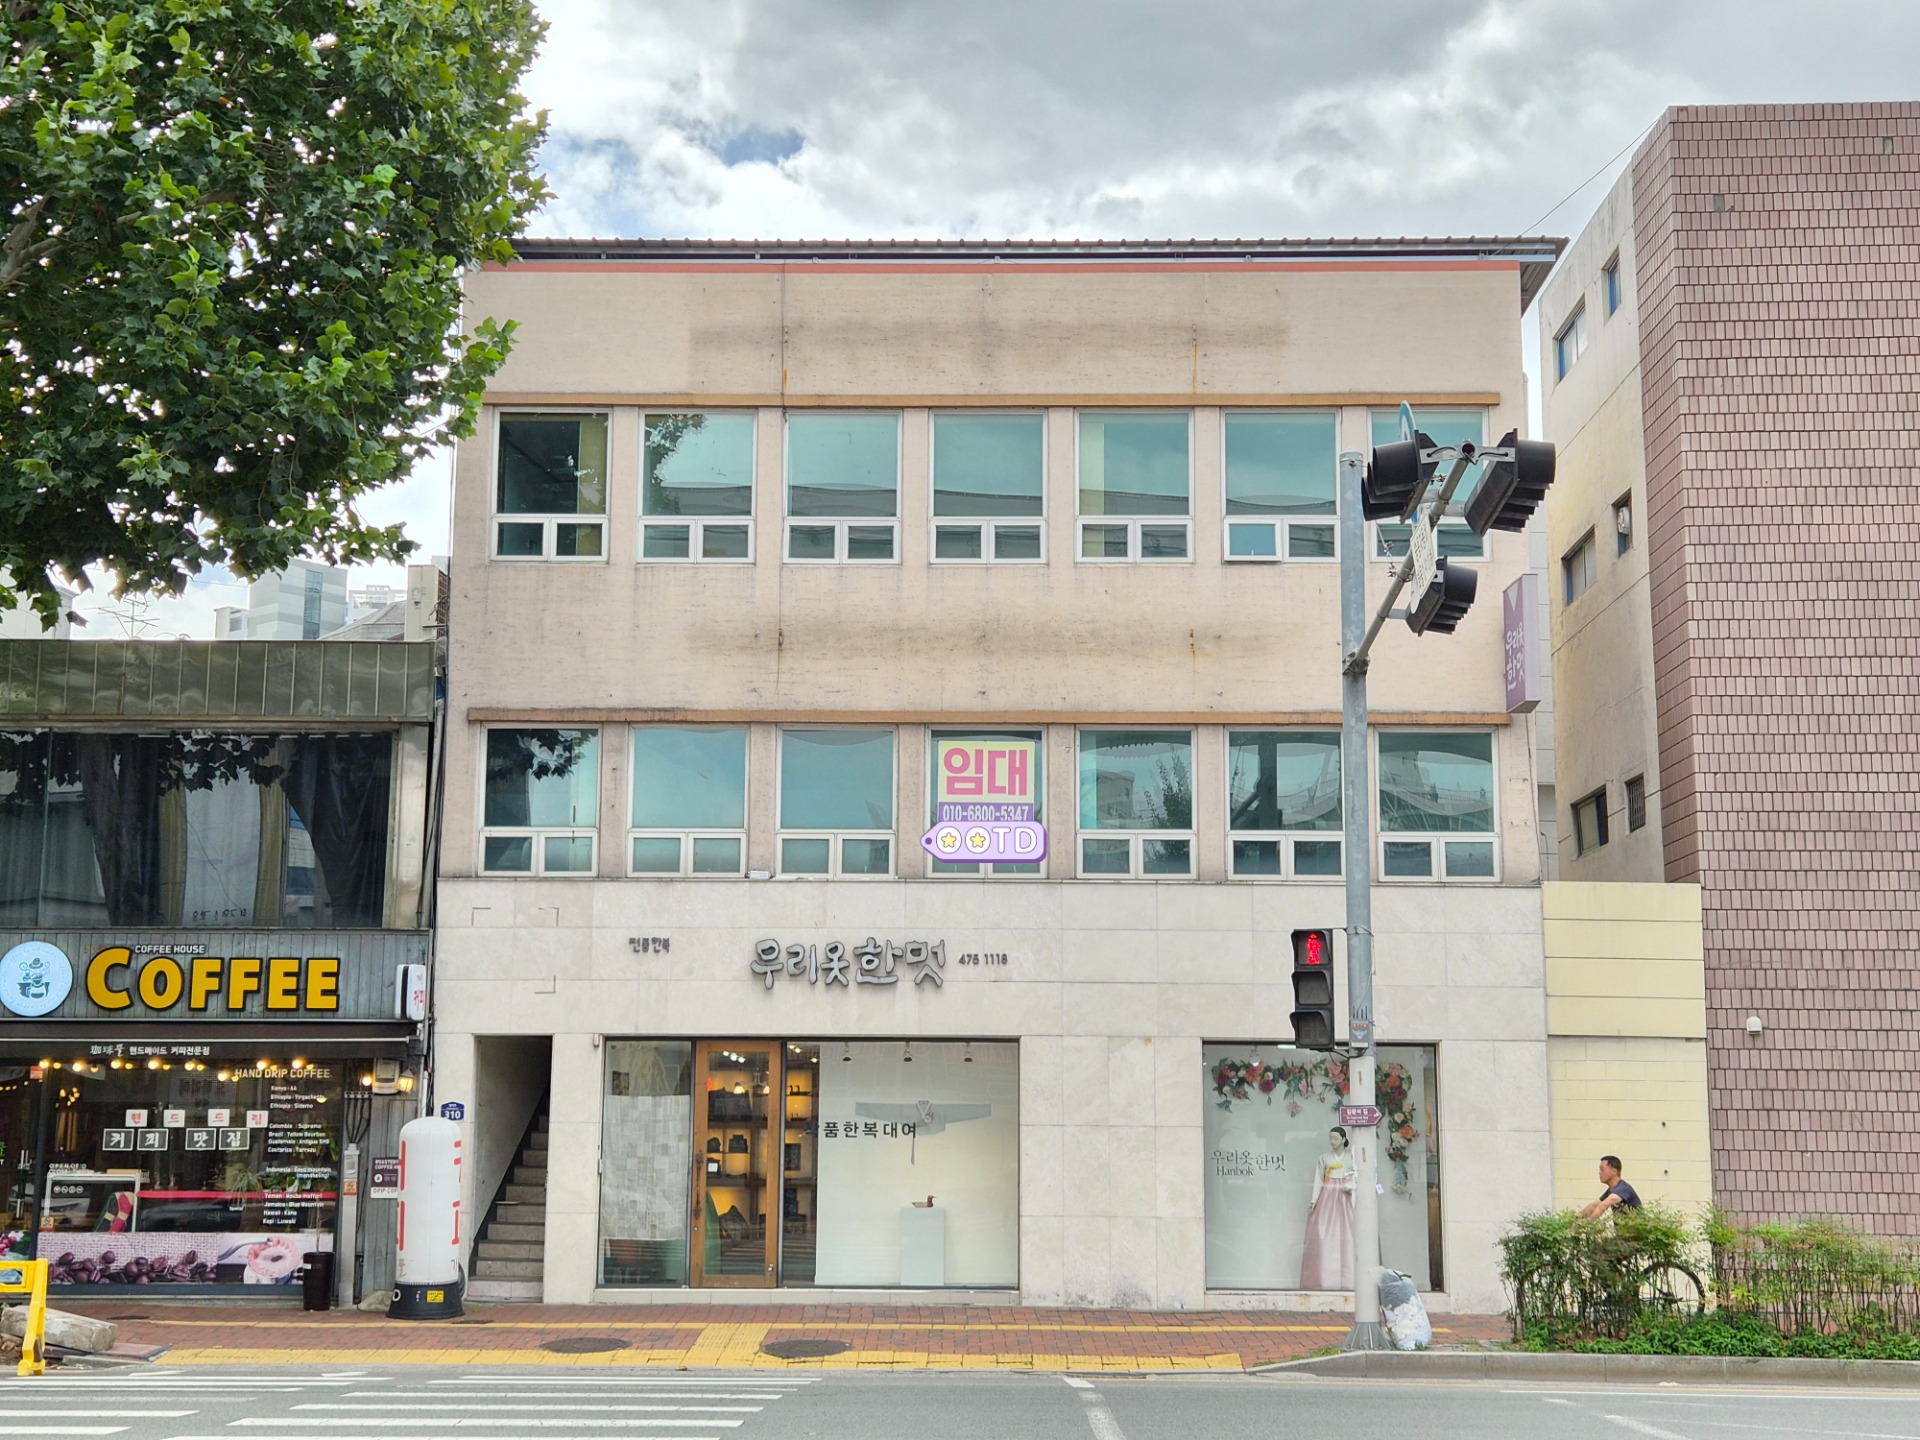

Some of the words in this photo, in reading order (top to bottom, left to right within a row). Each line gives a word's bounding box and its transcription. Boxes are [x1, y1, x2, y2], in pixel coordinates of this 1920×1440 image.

[944, 748, 1027, 796] 임대
[943, 804, 1029, 821] 010-6800-5347
[134, 945, 171, 953] COFFEE
[174, 945, 205, 953] HOUSE
[984, 953, 1008, 965] 1118
[86, 946, 340, 1011] COFFEE
[171, 1046, 210, 1055] 커피전문점
[235, 1069, 261, 1078] HAND
[264, 1069, 287, 1078] DRIP
[290, 1069, 331, 1078] COFFEE
[444, 1111, 461, 1119] 310
[193, 1132, 241, 1148] 맛집
[1217, 1166, 1253, 1176] Hanbok
